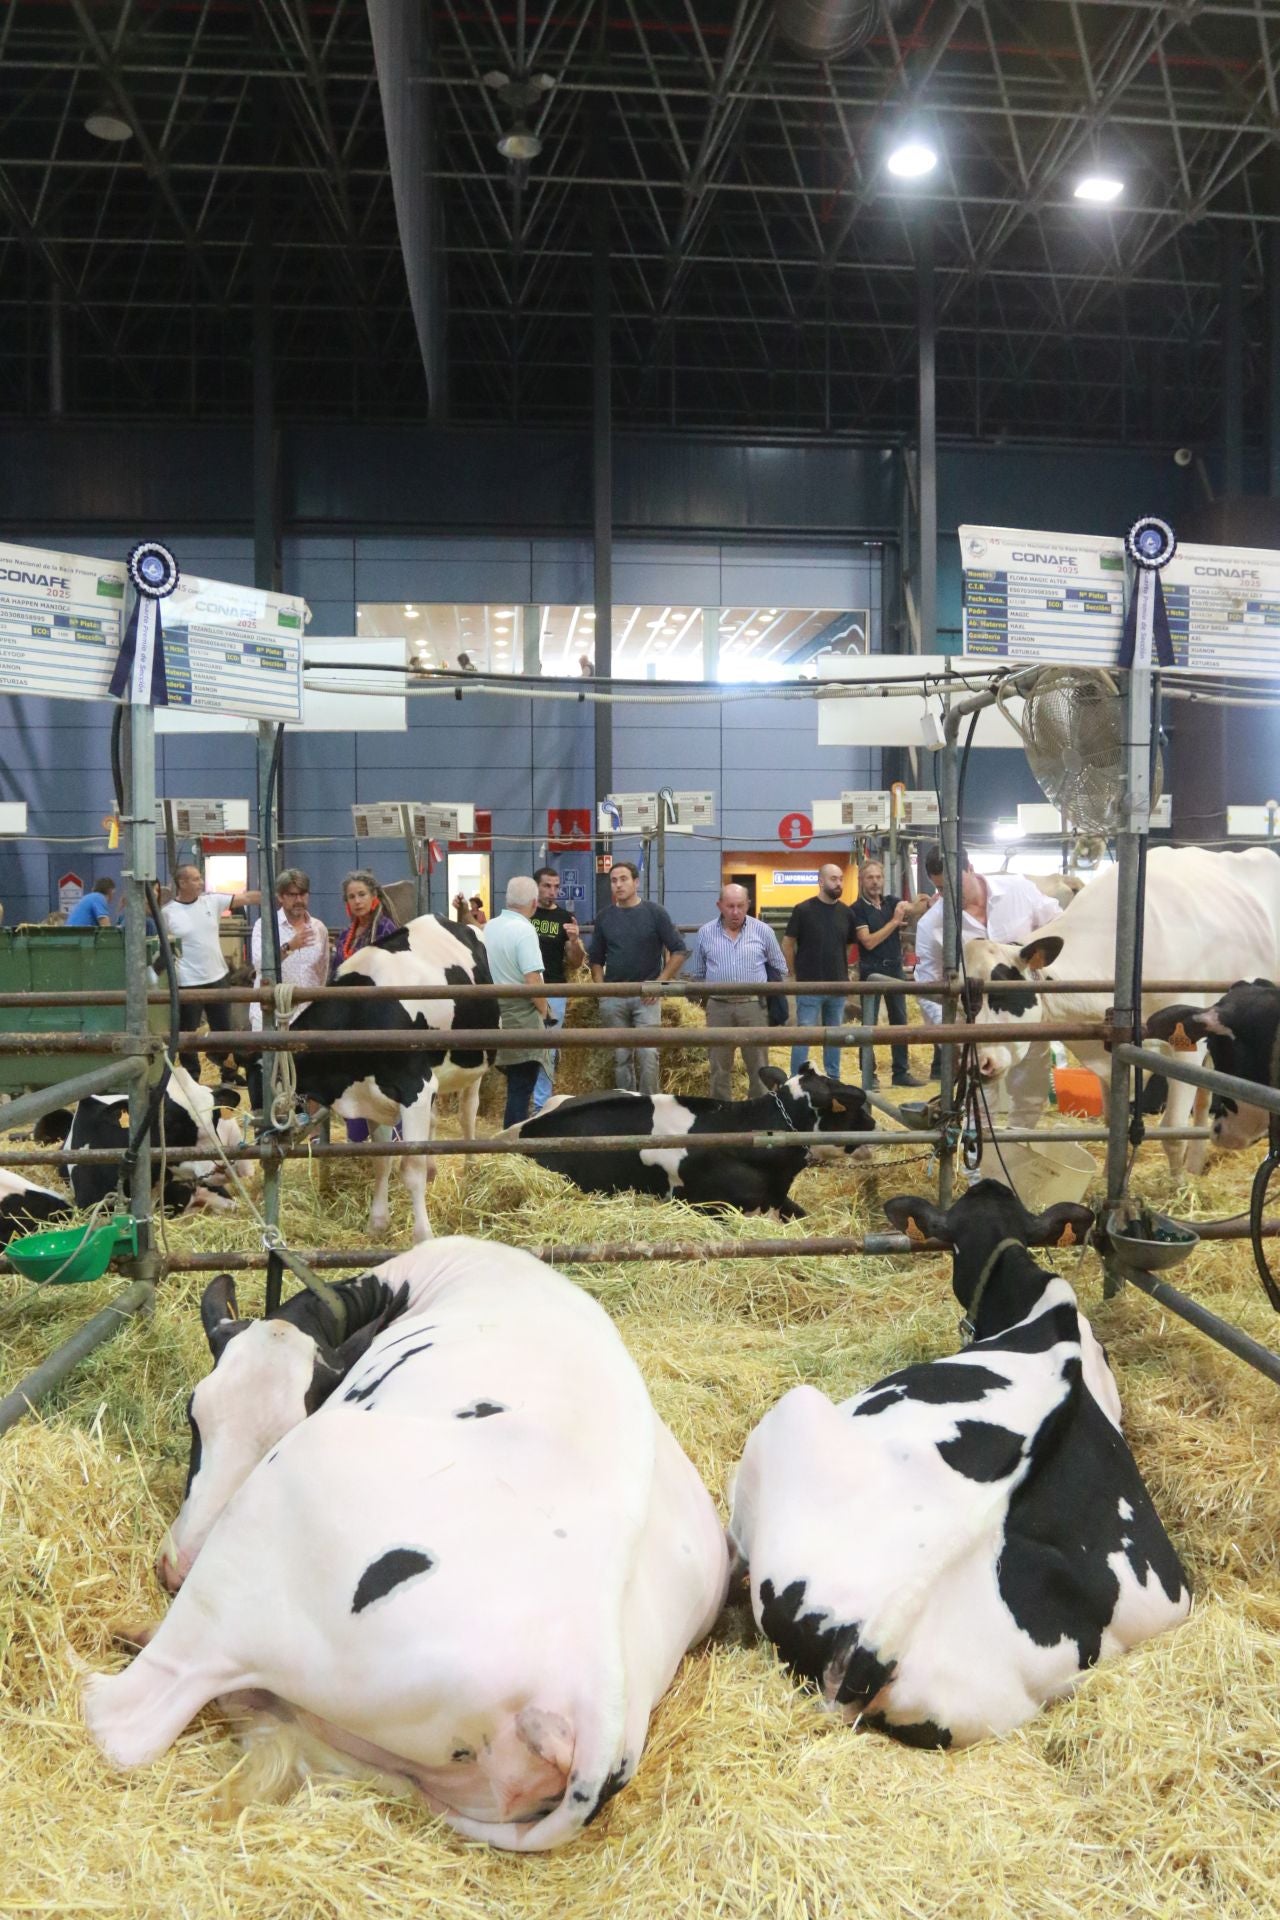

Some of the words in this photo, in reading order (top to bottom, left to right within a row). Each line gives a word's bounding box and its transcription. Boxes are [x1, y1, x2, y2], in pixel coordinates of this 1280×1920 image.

[1012, 552, 1078, 566] CONAFE
[1057, 566, 1079, 575] 2025
[1194, 566, 1260, 579] CONAFE
[0, 569, 71, 589] CONAFE
[47, 588, 71, 599] 2025
[968, 607, 987, 615] Padre
[237, 619, 257, 629] 2025
[530, 918, 560, 935] CON
